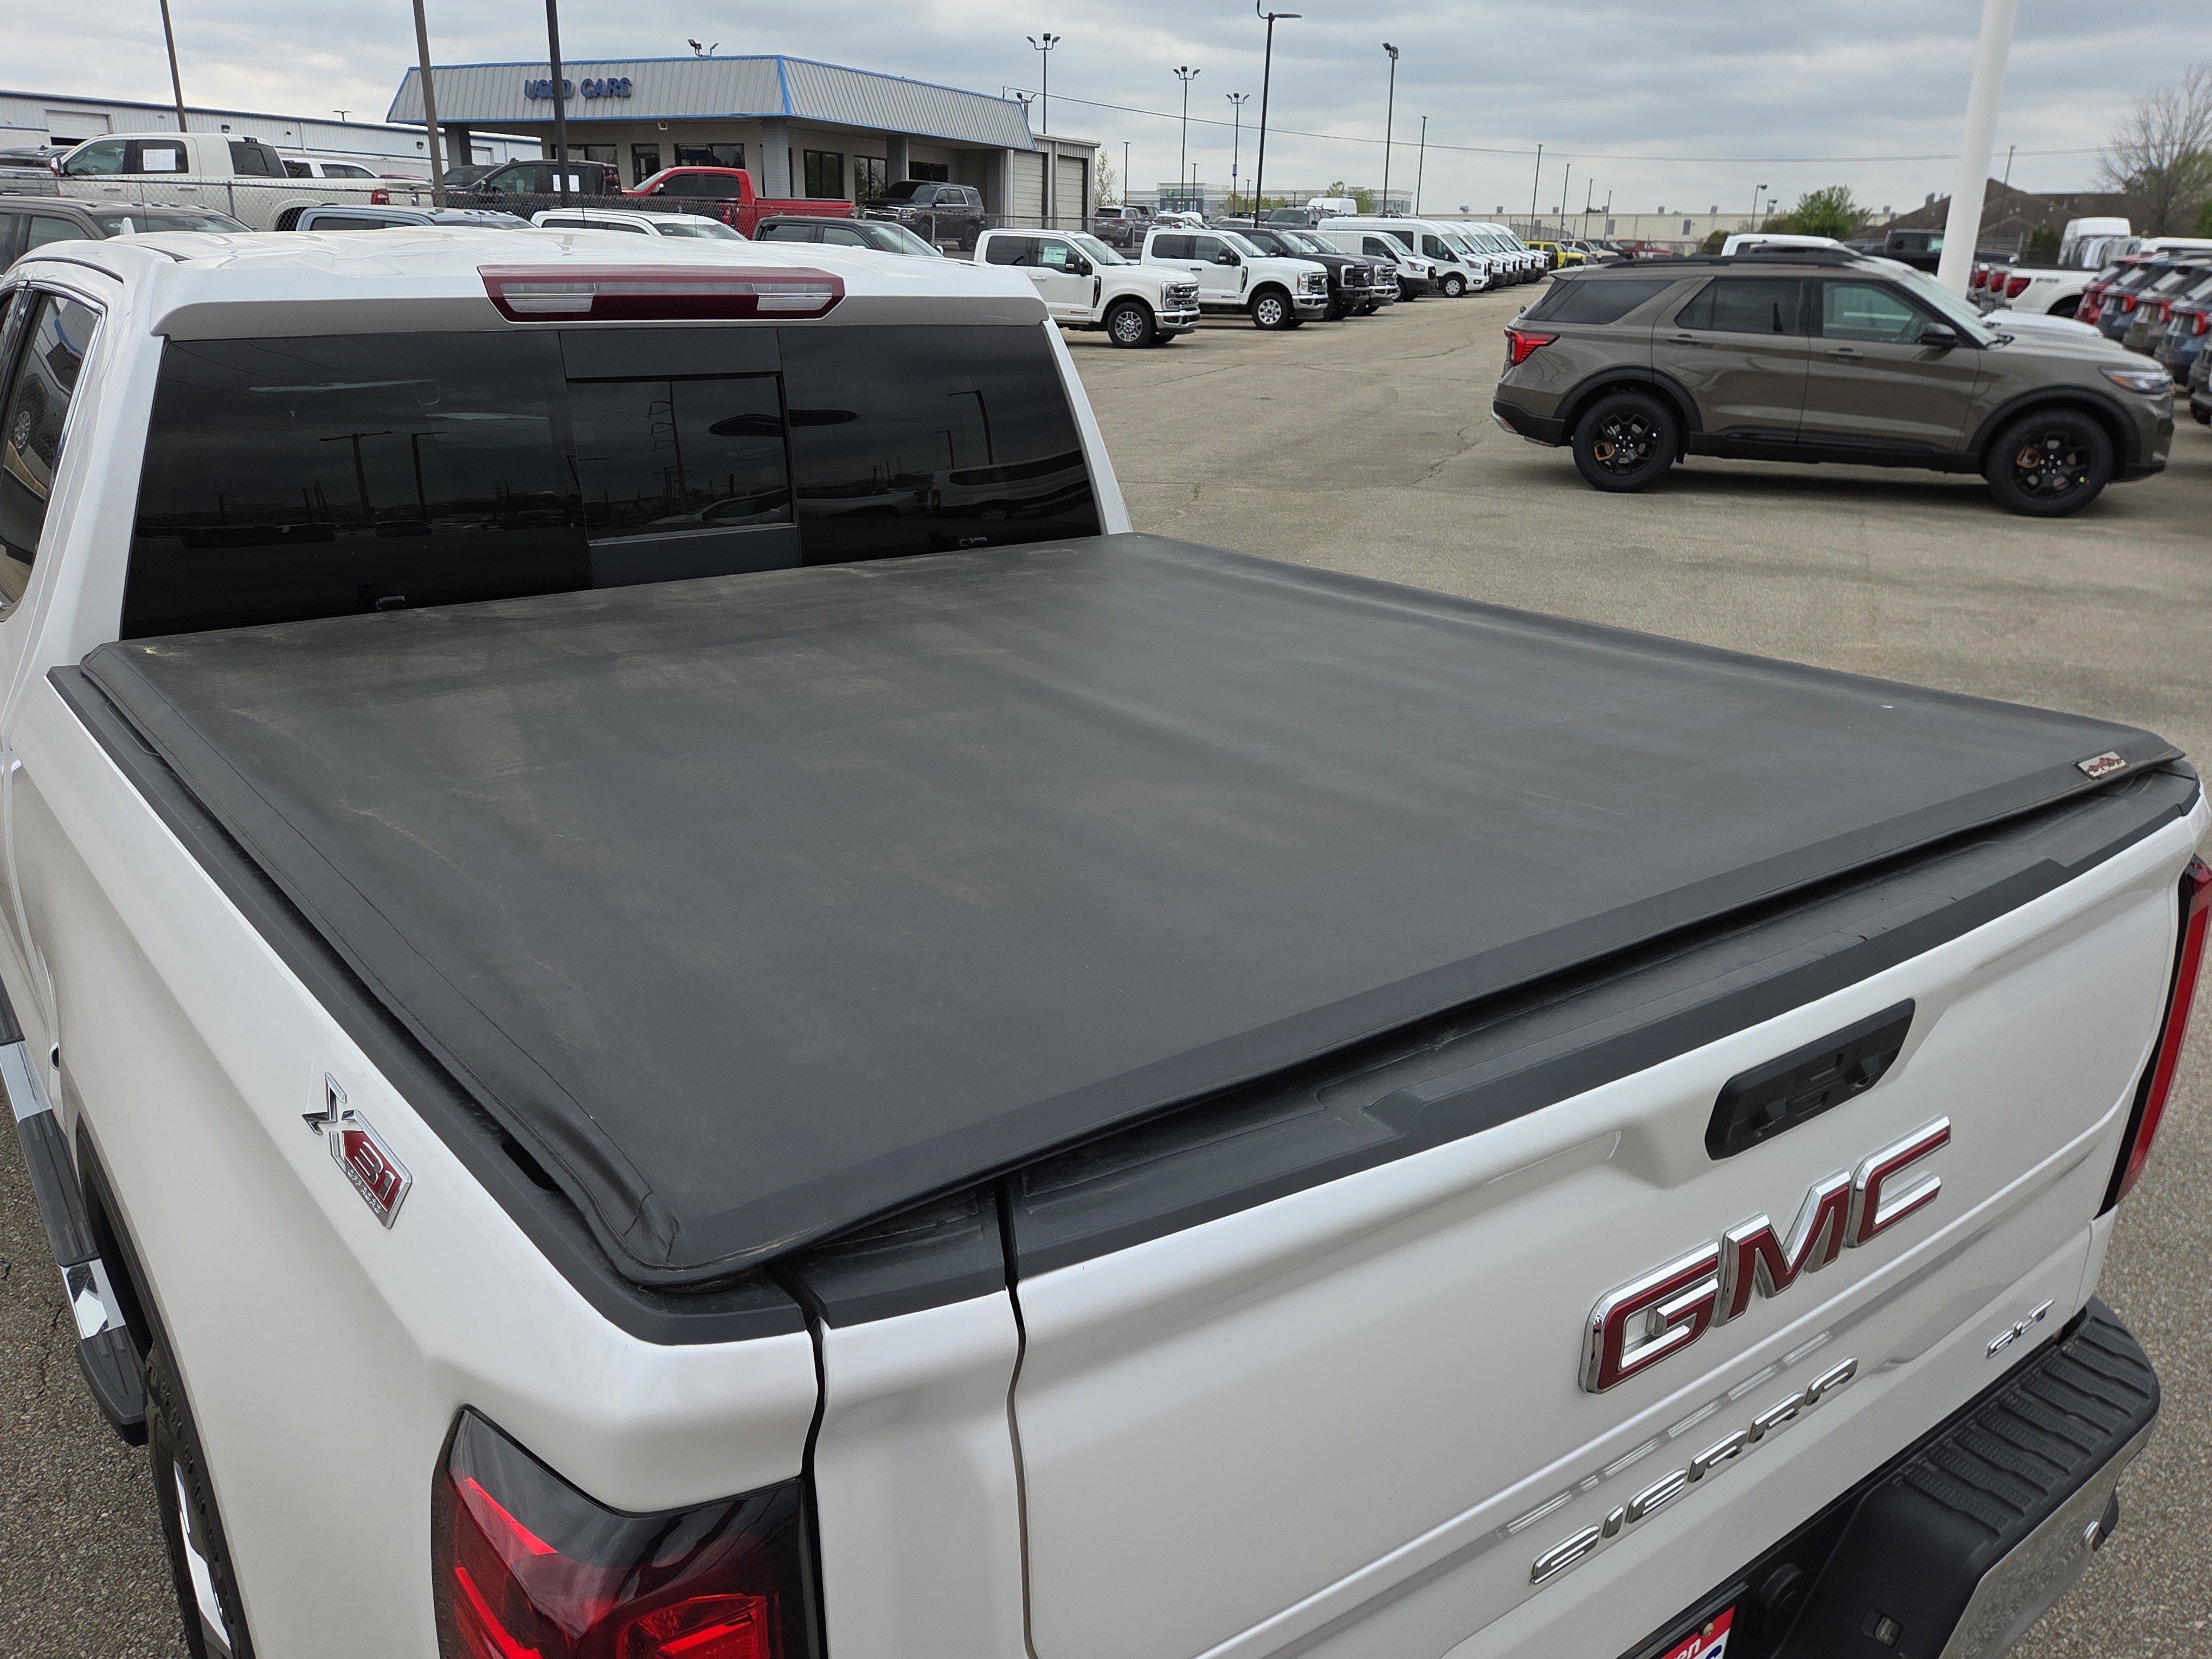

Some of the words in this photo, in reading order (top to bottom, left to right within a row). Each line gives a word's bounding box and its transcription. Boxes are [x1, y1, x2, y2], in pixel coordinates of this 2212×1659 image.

[580, 77, 633, 99] CARS
[1578, 1113, 1951, 1394] GMC
[1529, 1355, 1859, 1585] SIERRA
